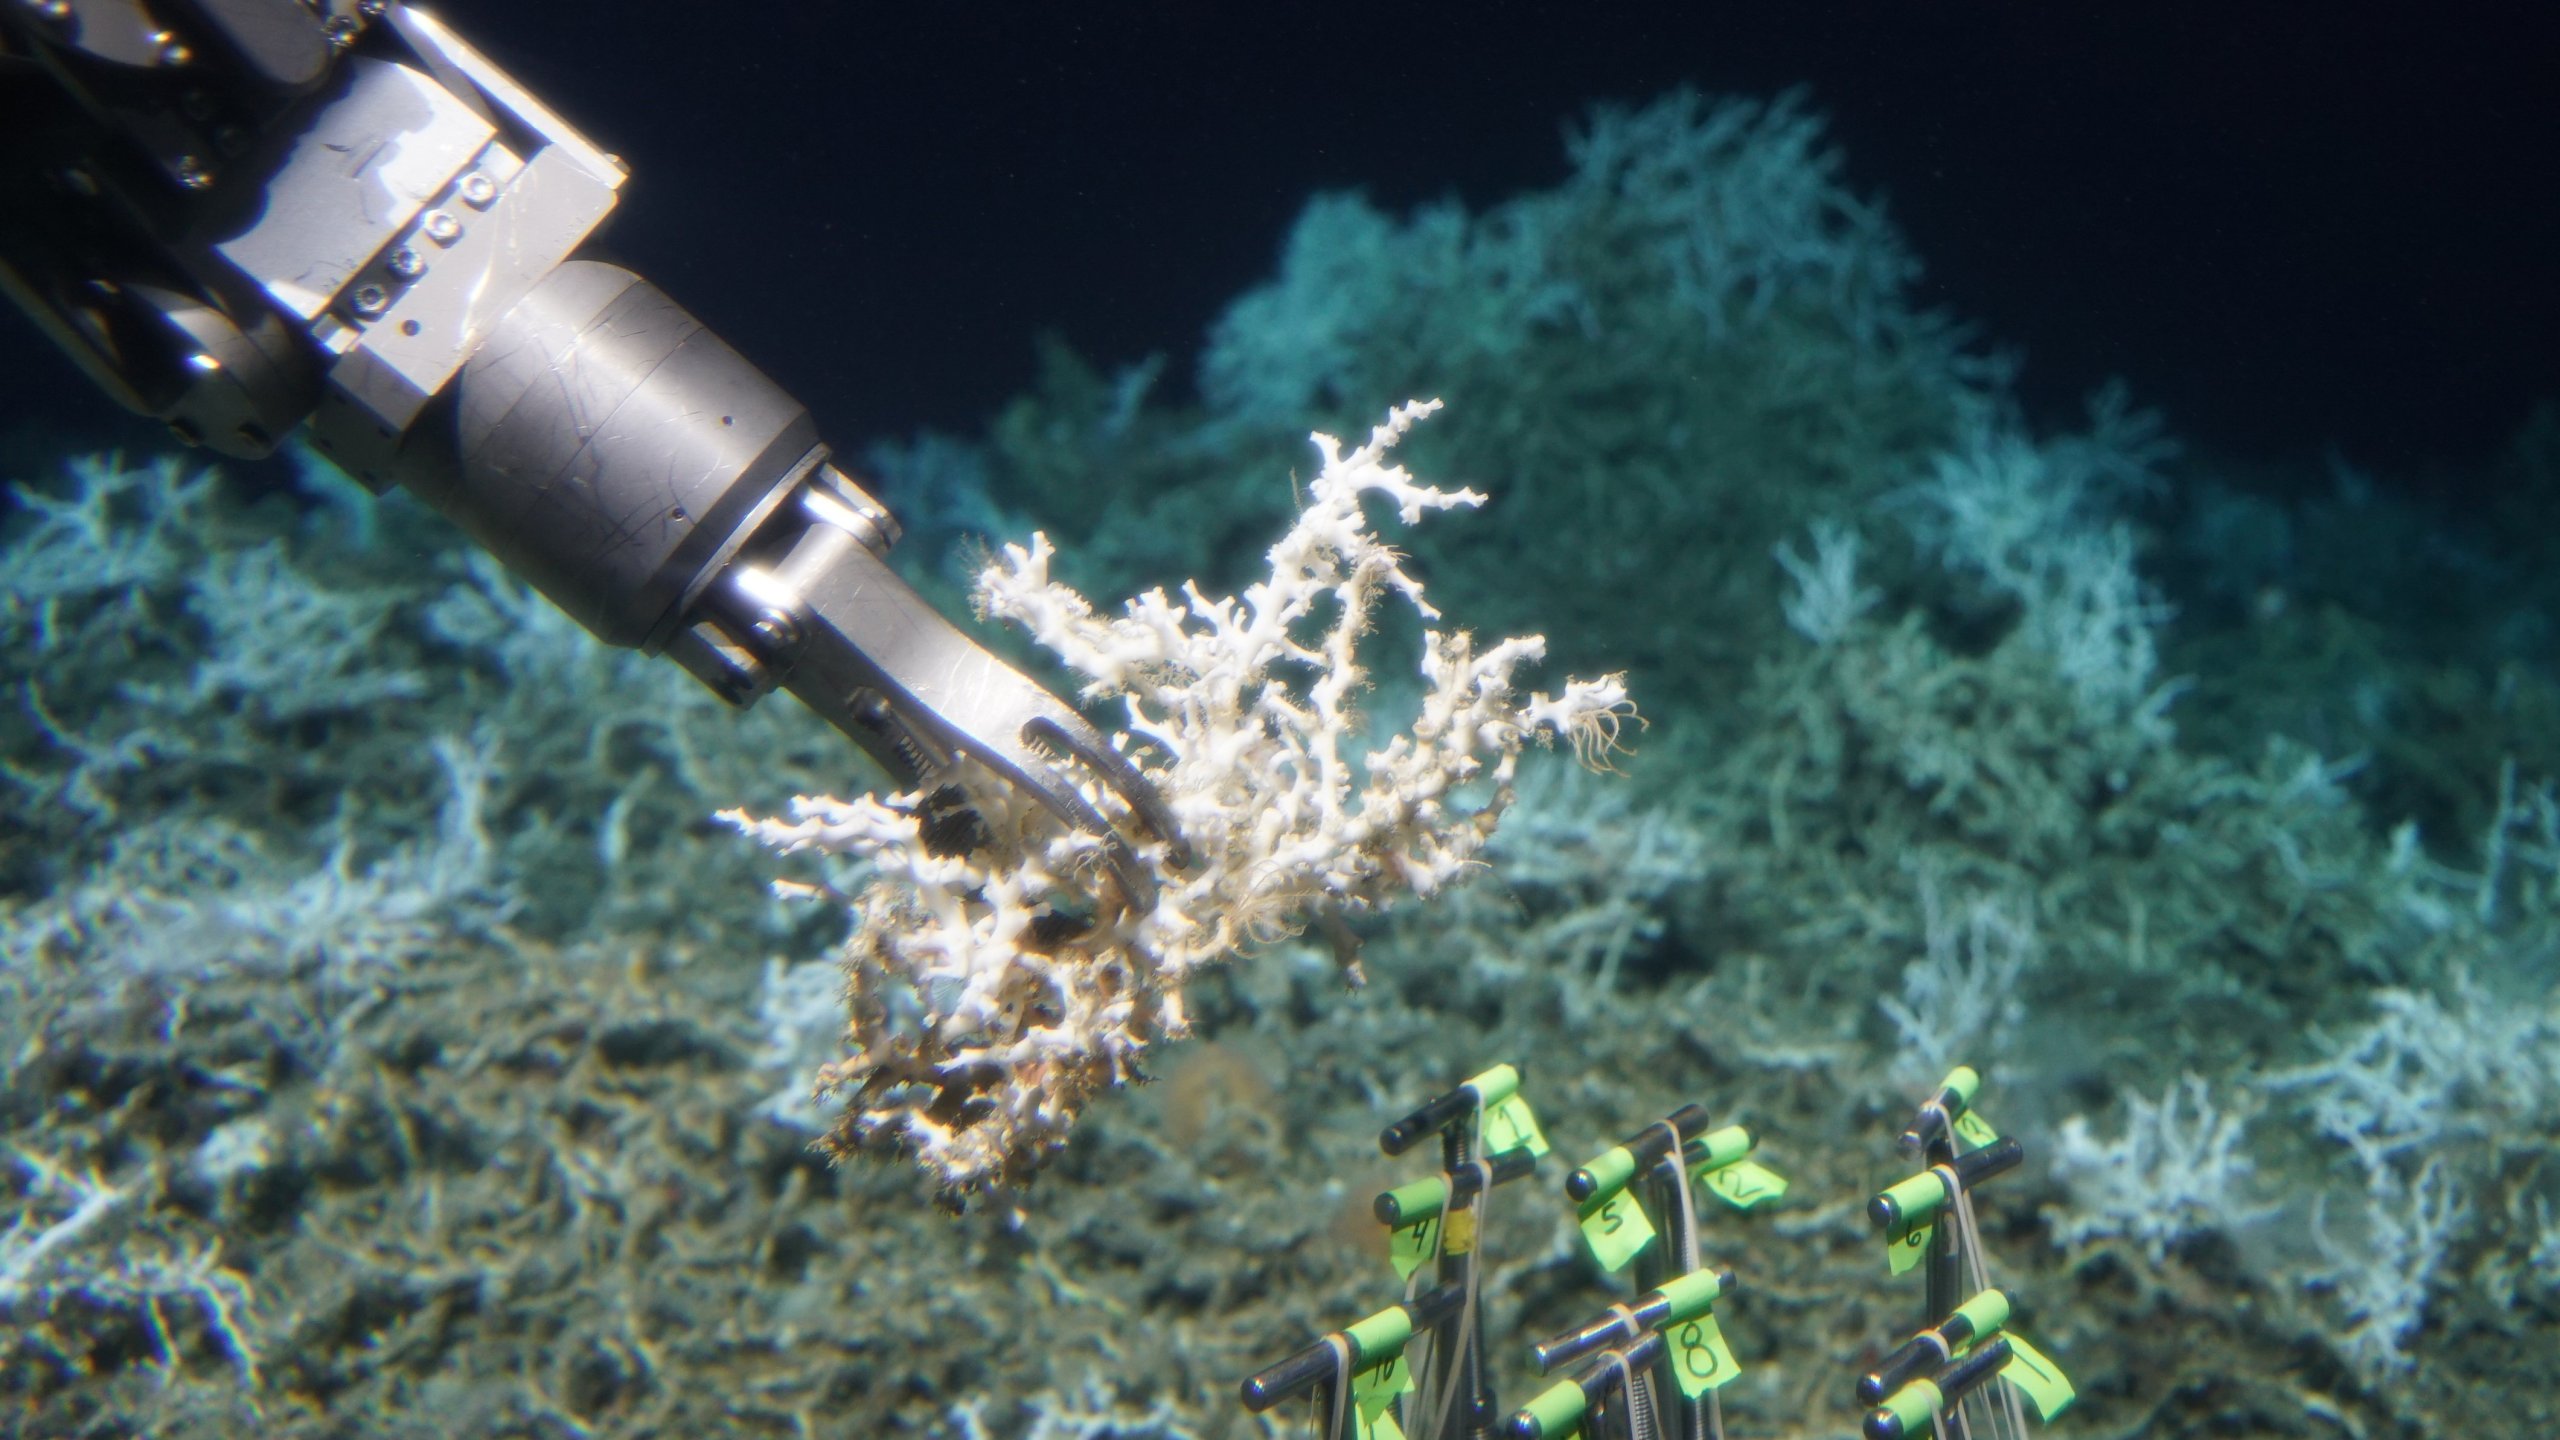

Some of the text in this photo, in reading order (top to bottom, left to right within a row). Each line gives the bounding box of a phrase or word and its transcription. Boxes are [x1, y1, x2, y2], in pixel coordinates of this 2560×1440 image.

[1718, 1169, 1764, 1198] 2
[1412, 1217, 1430, 1252] 4
[1601, 1200, 1623, 1235] 5
[1906, 1217, 1921, 1247] 6
[1680, 1321, 1718, 1378] 8
